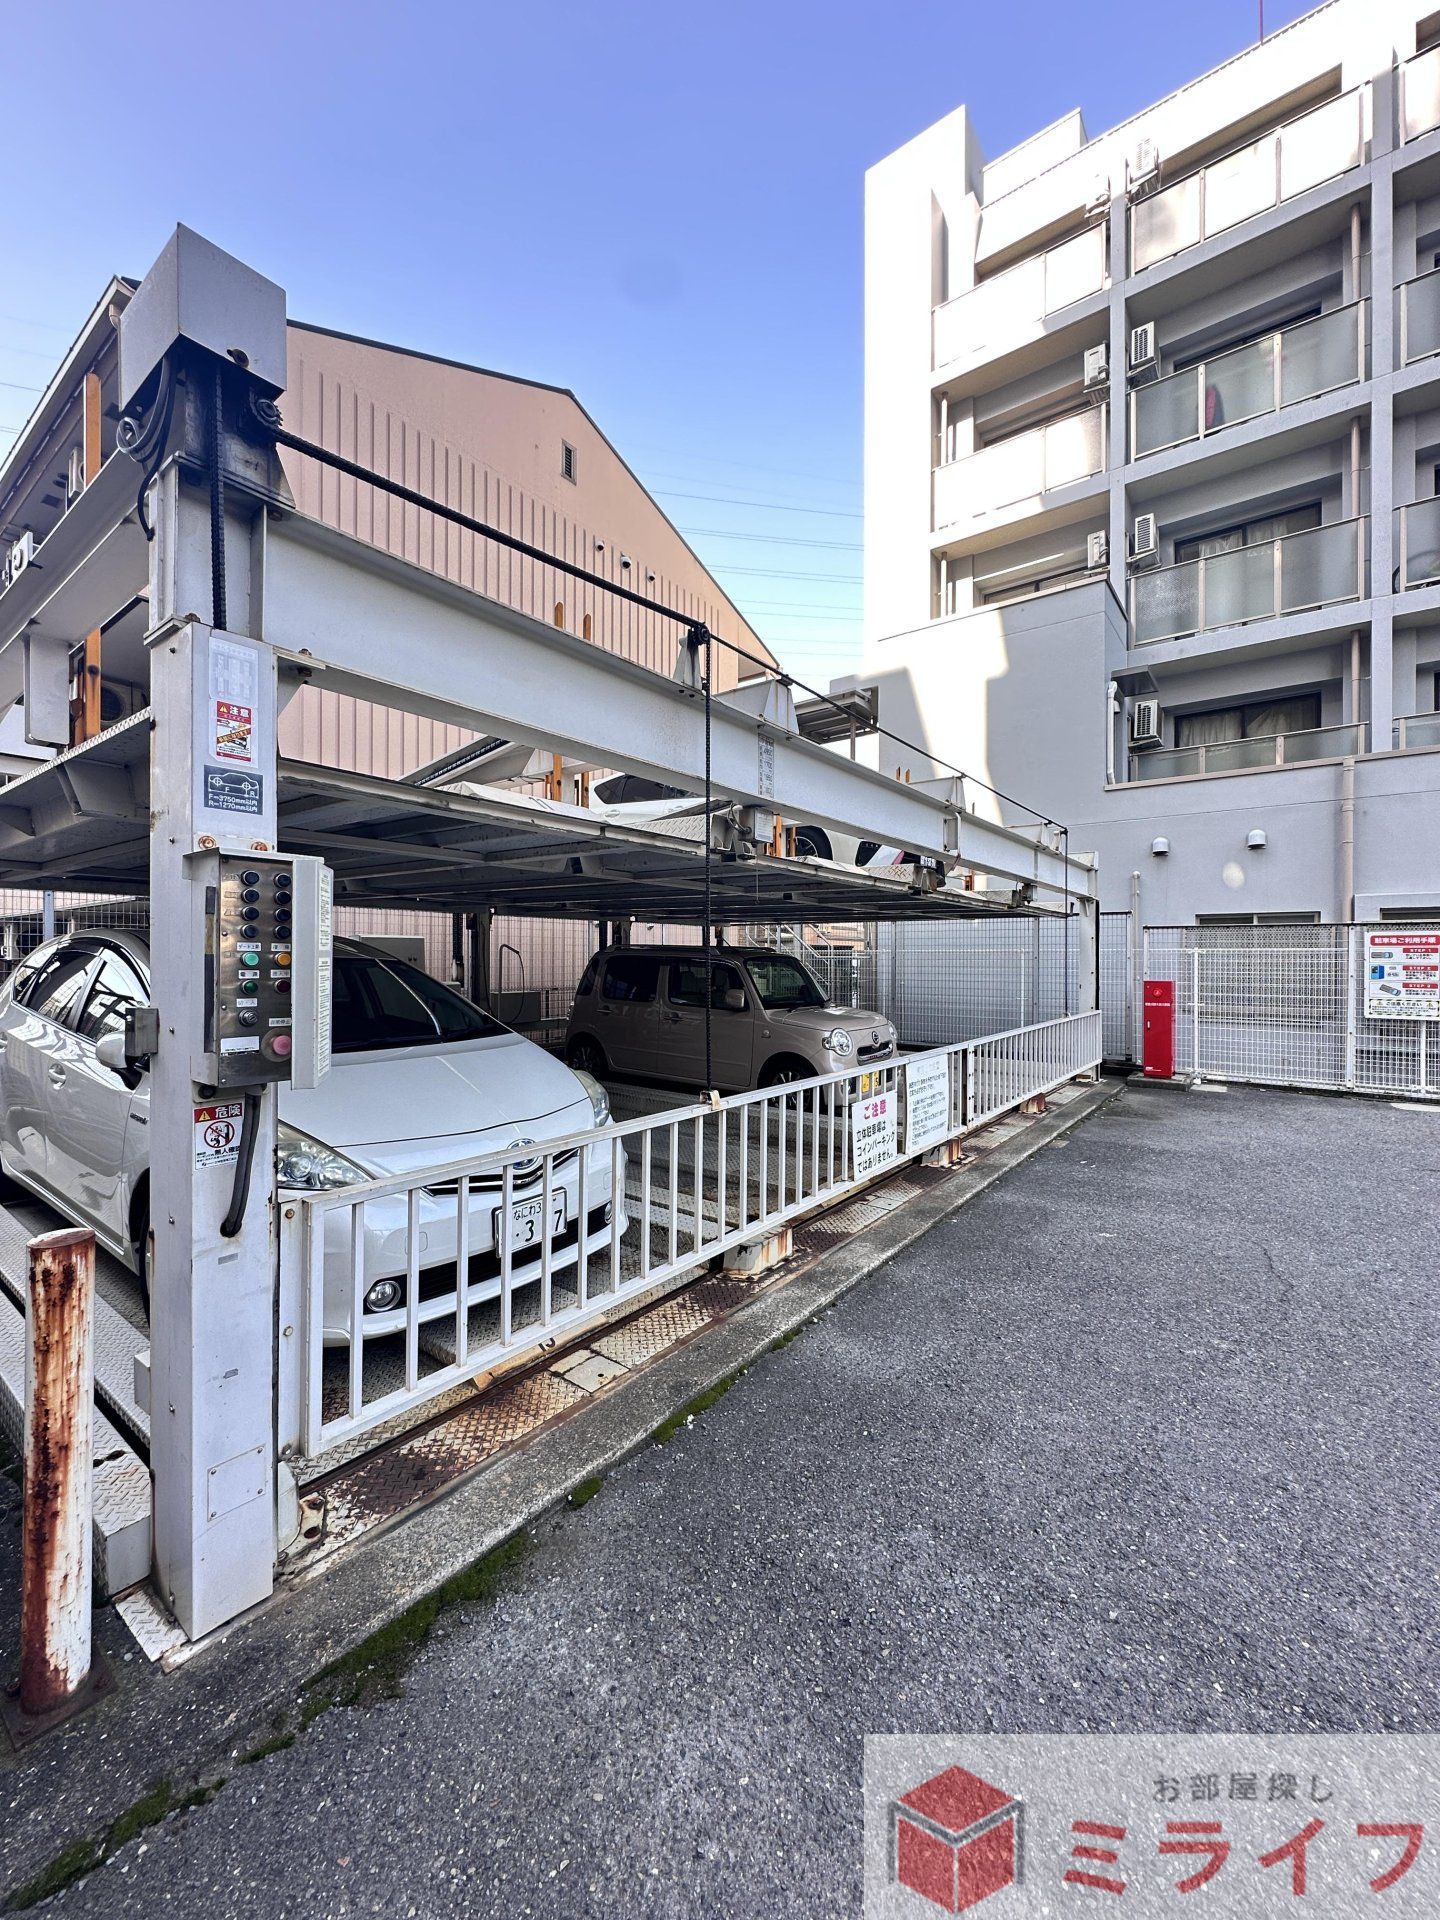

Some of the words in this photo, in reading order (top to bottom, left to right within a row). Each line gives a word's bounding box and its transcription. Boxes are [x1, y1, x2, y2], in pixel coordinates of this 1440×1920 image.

[229, 705, 250, 718] 注意
[215, 1104, 241, 1119] 危険
[864, 1099, 887, 1120] ご注意
[856, 1120, 887, 1143] 立体駐車場は
[857, 1130, 895, 1157] コインパーキング
[857, 1147, 894, 1173] ではありません。
